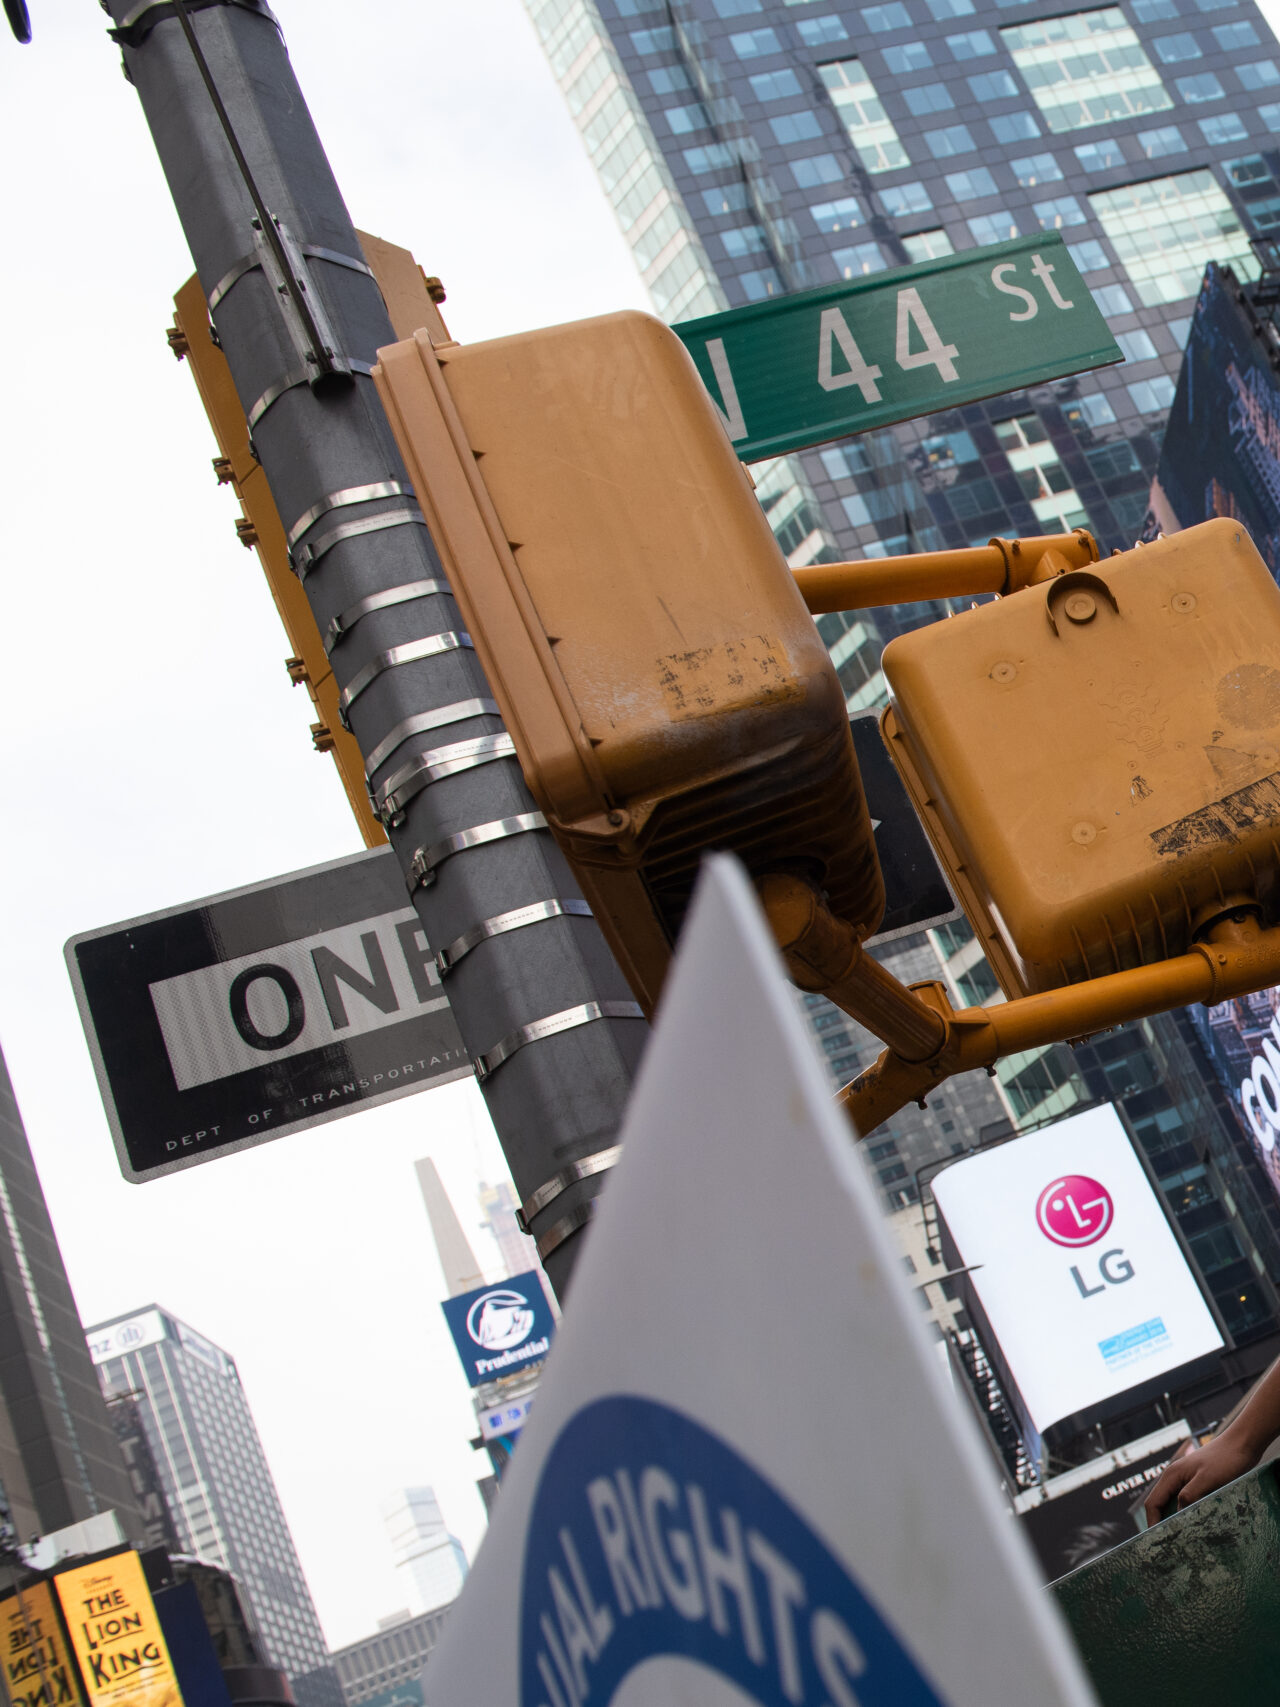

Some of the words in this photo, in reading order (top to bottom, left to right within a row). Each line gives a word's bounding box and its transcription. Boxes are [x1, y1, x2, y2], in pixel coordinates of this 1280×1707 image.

[817, 287, 960, 405] 44
[991, 254, 1074, 322] St
[229, 918, 448, 1051] ONE
[166, 1125, 222, 1151] DEPT
[248, 1108, 274, 1126] OF
[298, 1047, 468, 1107] TRANSPORTATI
[1069, 1249, 1136, 1299] LG
[475, 1336, 550, 1376] Prudential
[1102, 1473, 1145, 1500] OLIVER
[82, 1588, 125, 1615] THE
